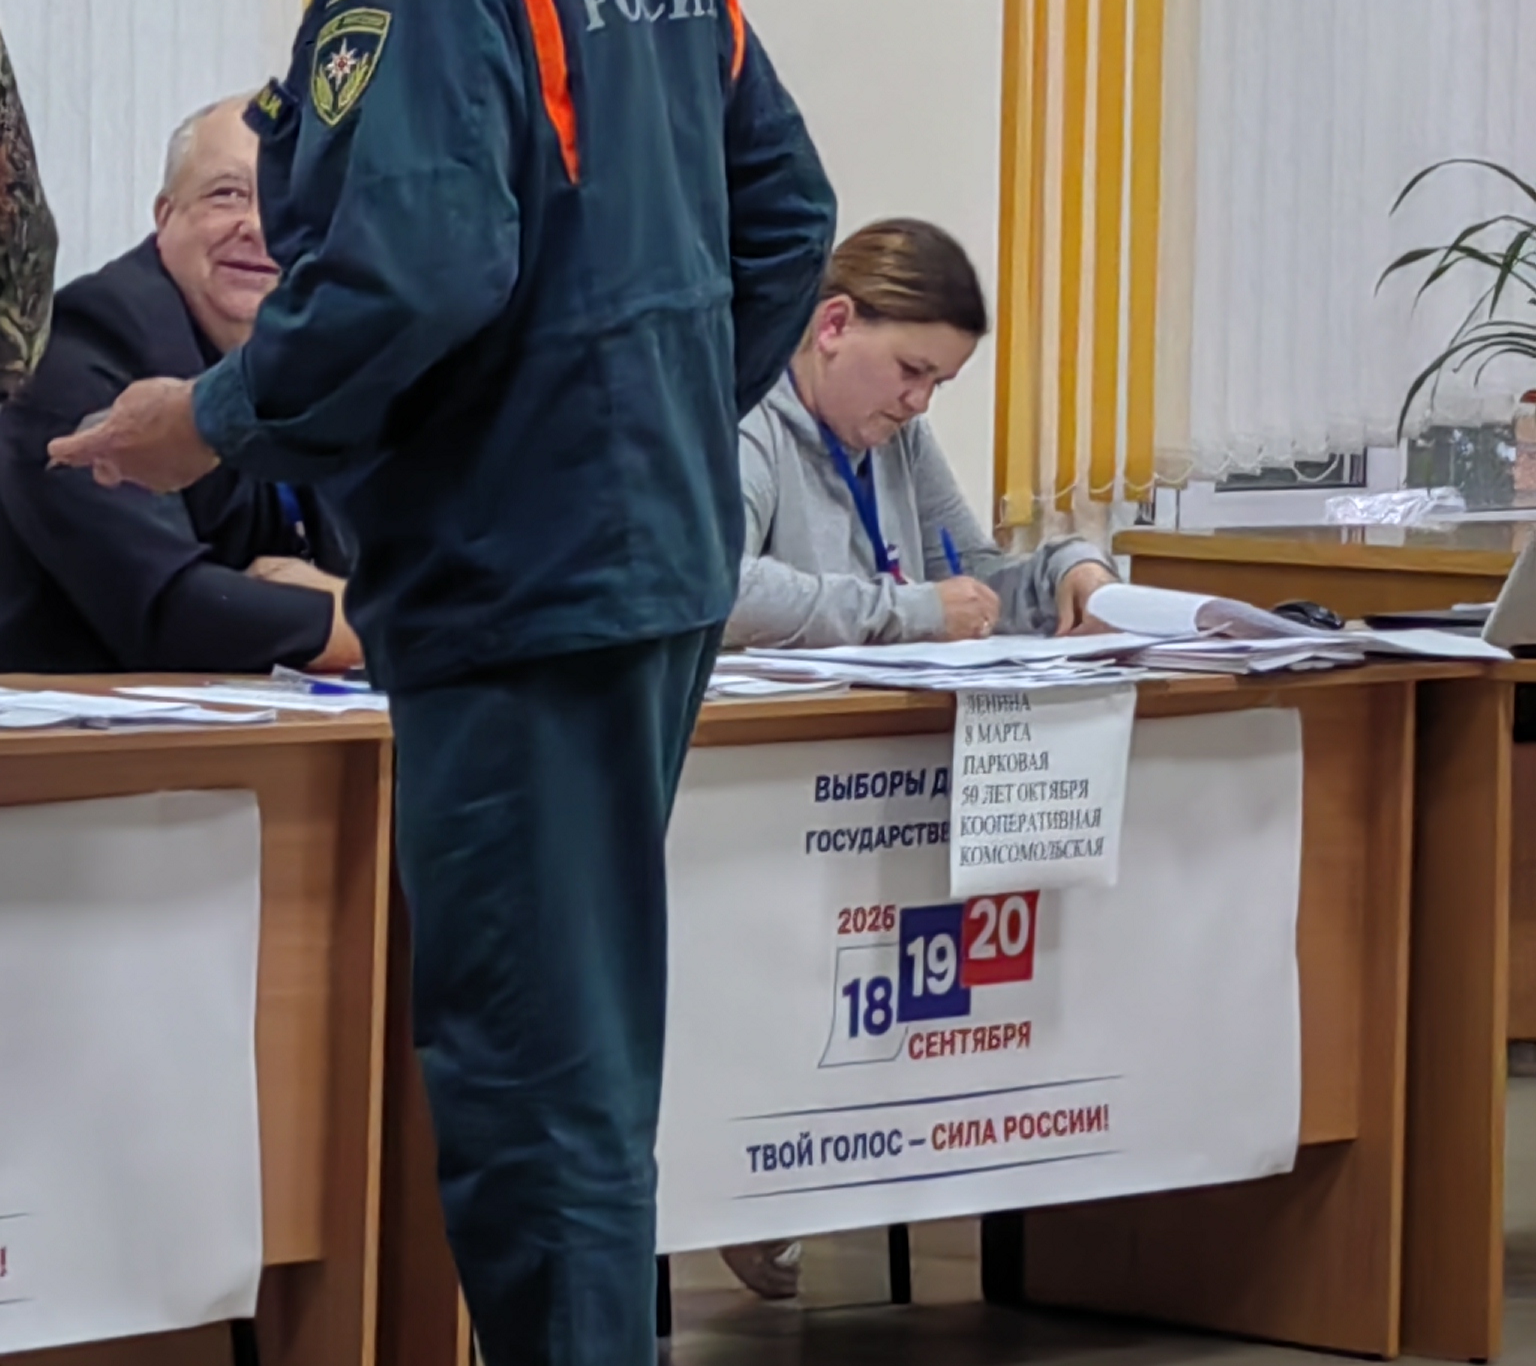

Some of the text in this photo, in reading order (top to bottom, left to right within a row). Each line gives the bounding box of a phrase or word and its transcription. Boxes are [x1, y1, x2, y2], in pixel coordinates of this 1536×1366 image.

[965, 693, 1031, 715] ЛЕНИНА
[965, 722, 1031, 746] 8 МАРТА
[962, 751, 1048, 775] ПАРКОВАЯ
[815, 768, 926, 802] ВЫБОРЫ
[961, 779, 1089, 806] 50 ЛЕТ ОКТЯБРЯ
[960, 807, 1101, 837] КООПЕРАТИВНАЯ
[959, 836, 1104, 866] КОМСОМОЛЬСКАЯ
[837, 904, 895, 934] 2026
[842, 895, 1030, 1038] 18 19 20
[908, 1020, 1032, 1060] СЕНТЯБРЯ
[746, 1132, 813, 1173] ТВОЙ
[820, 1129, 902, 1166] ГОЛОС
[931, 1118, 997, 1151] СИЛА
[1004, 1104, 1109, 1139] РОССИИ!
